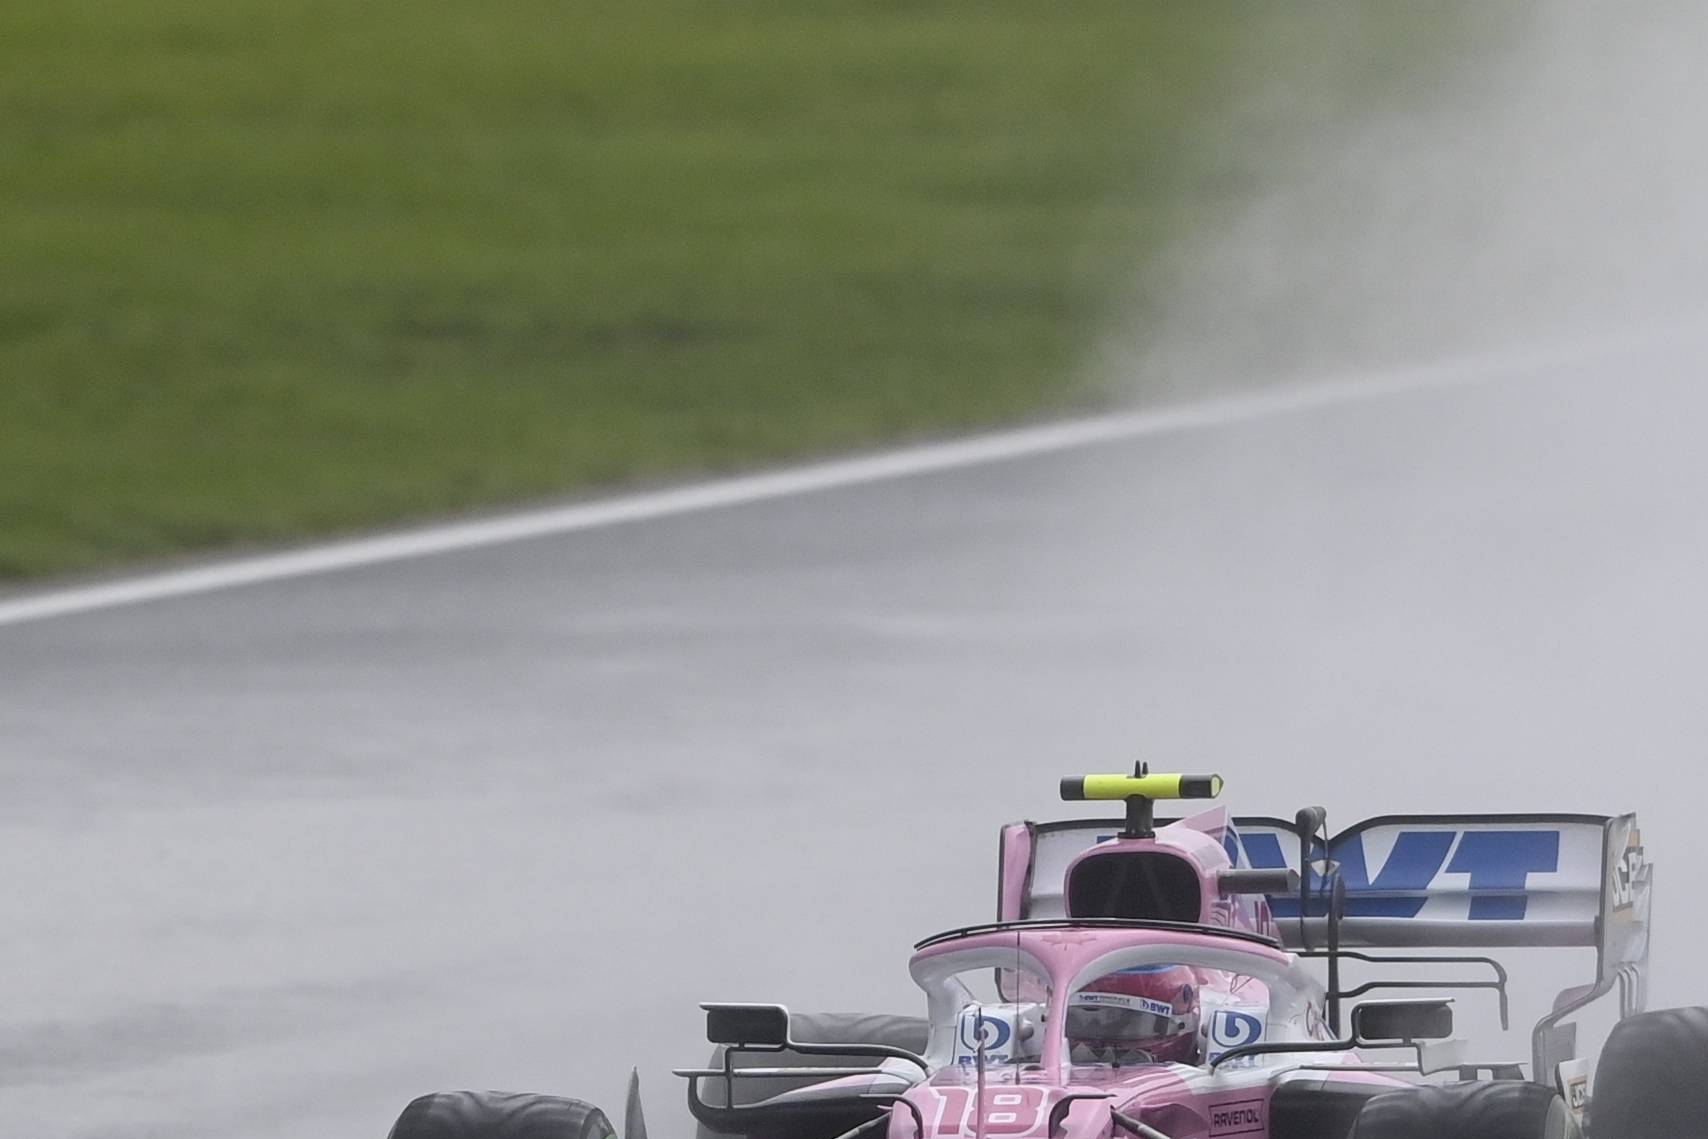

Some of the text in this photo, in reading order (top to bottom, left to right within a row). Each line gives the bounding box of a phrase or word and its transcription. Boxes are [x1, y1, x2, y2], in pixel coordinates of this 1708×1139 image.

[1222, 829, 1560, 920] WT
[1150, 1002, 1170, 1016] BWT
[929, 1085, 1050, 1137] 18
[1213, 1108, 1259, 1129] RAVENOL
